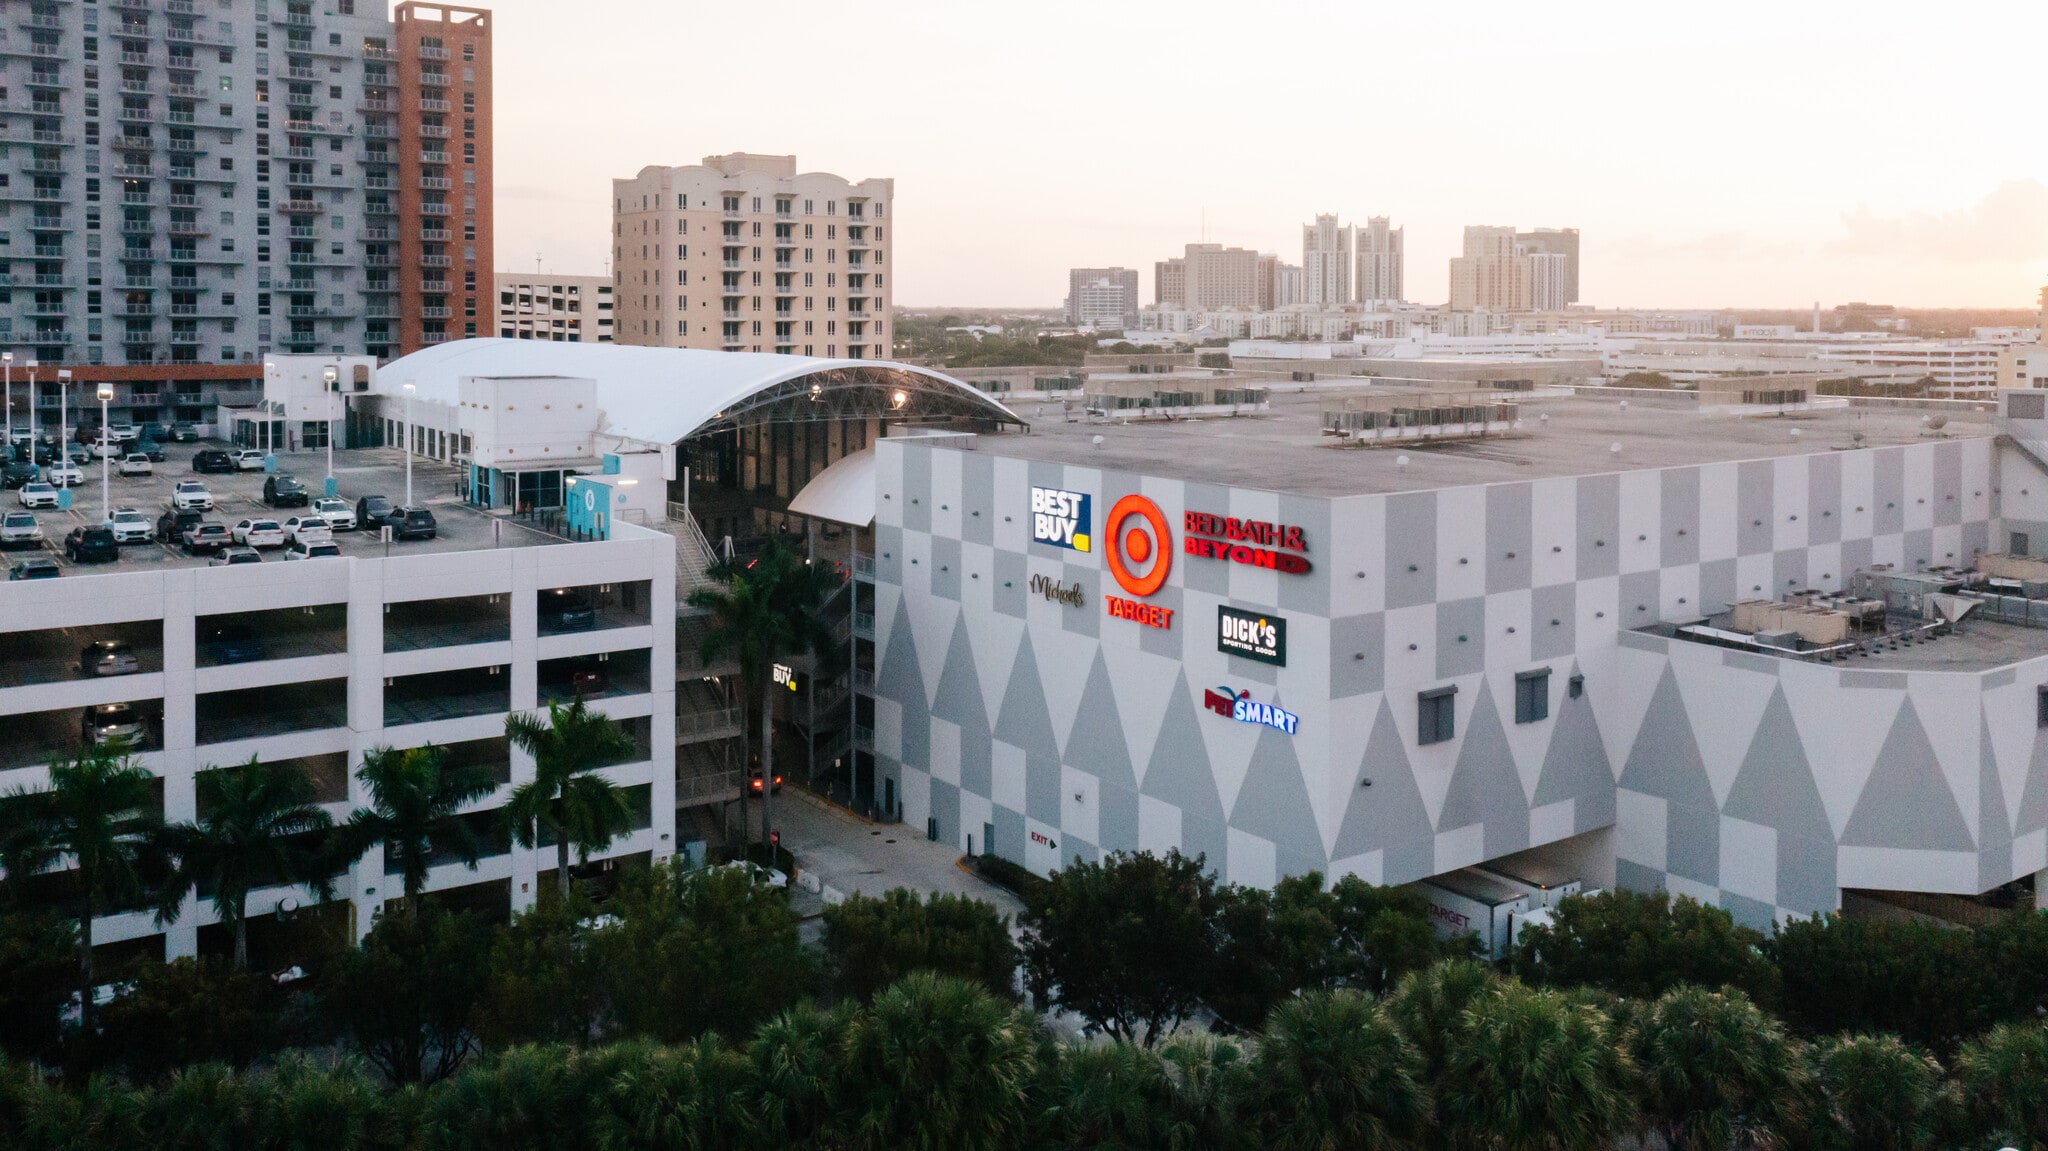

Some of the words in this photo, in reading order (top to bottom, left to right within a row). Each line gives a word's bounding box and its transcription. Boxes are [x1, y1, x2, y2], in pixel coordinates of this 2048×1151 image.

[1032, 487, 1082, 519] BEST
[1034, 513, 1077, 545] BUY
[1184, 510, 1226, 537] BED
[1226, 517, 1285, 548] BATH
[1184, 536, 1311, 574] BEYOND
[1029, 573, 1083, 608] Michaels
[1104, 594, 1174, 630] TARGET
[1222, 615, 1276, 648] DICK'S
[1223, 639, 1253, 651] SPORTING
[1255, 646, 1277, 657] GOODS
[773, 667, 792, 687] BUY
[1204, 688, 1298, 735] PETSMART
[1031, 831, 1048, 846] EXIT
[1429, 903, 1470, 928] TARGET
